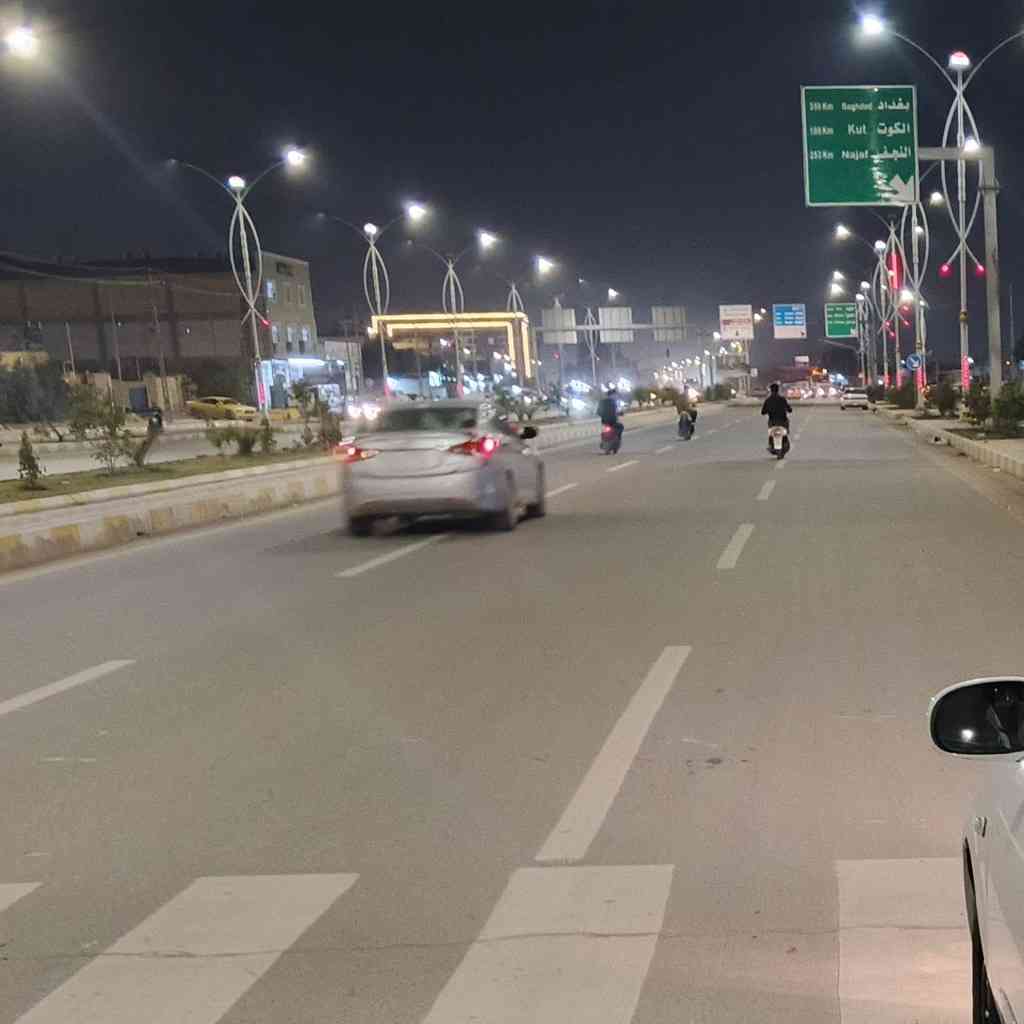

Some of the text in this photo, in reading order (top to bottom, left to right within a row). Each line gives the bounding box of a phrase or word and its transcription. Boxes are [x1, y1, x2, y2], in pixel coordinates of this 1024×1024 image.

[878, 98, 911, 112] بغداد
[847, 124, 867, 135] Kut
[877, 122, 911, 137] الكوت
[822, 150, 834, 160] Km
